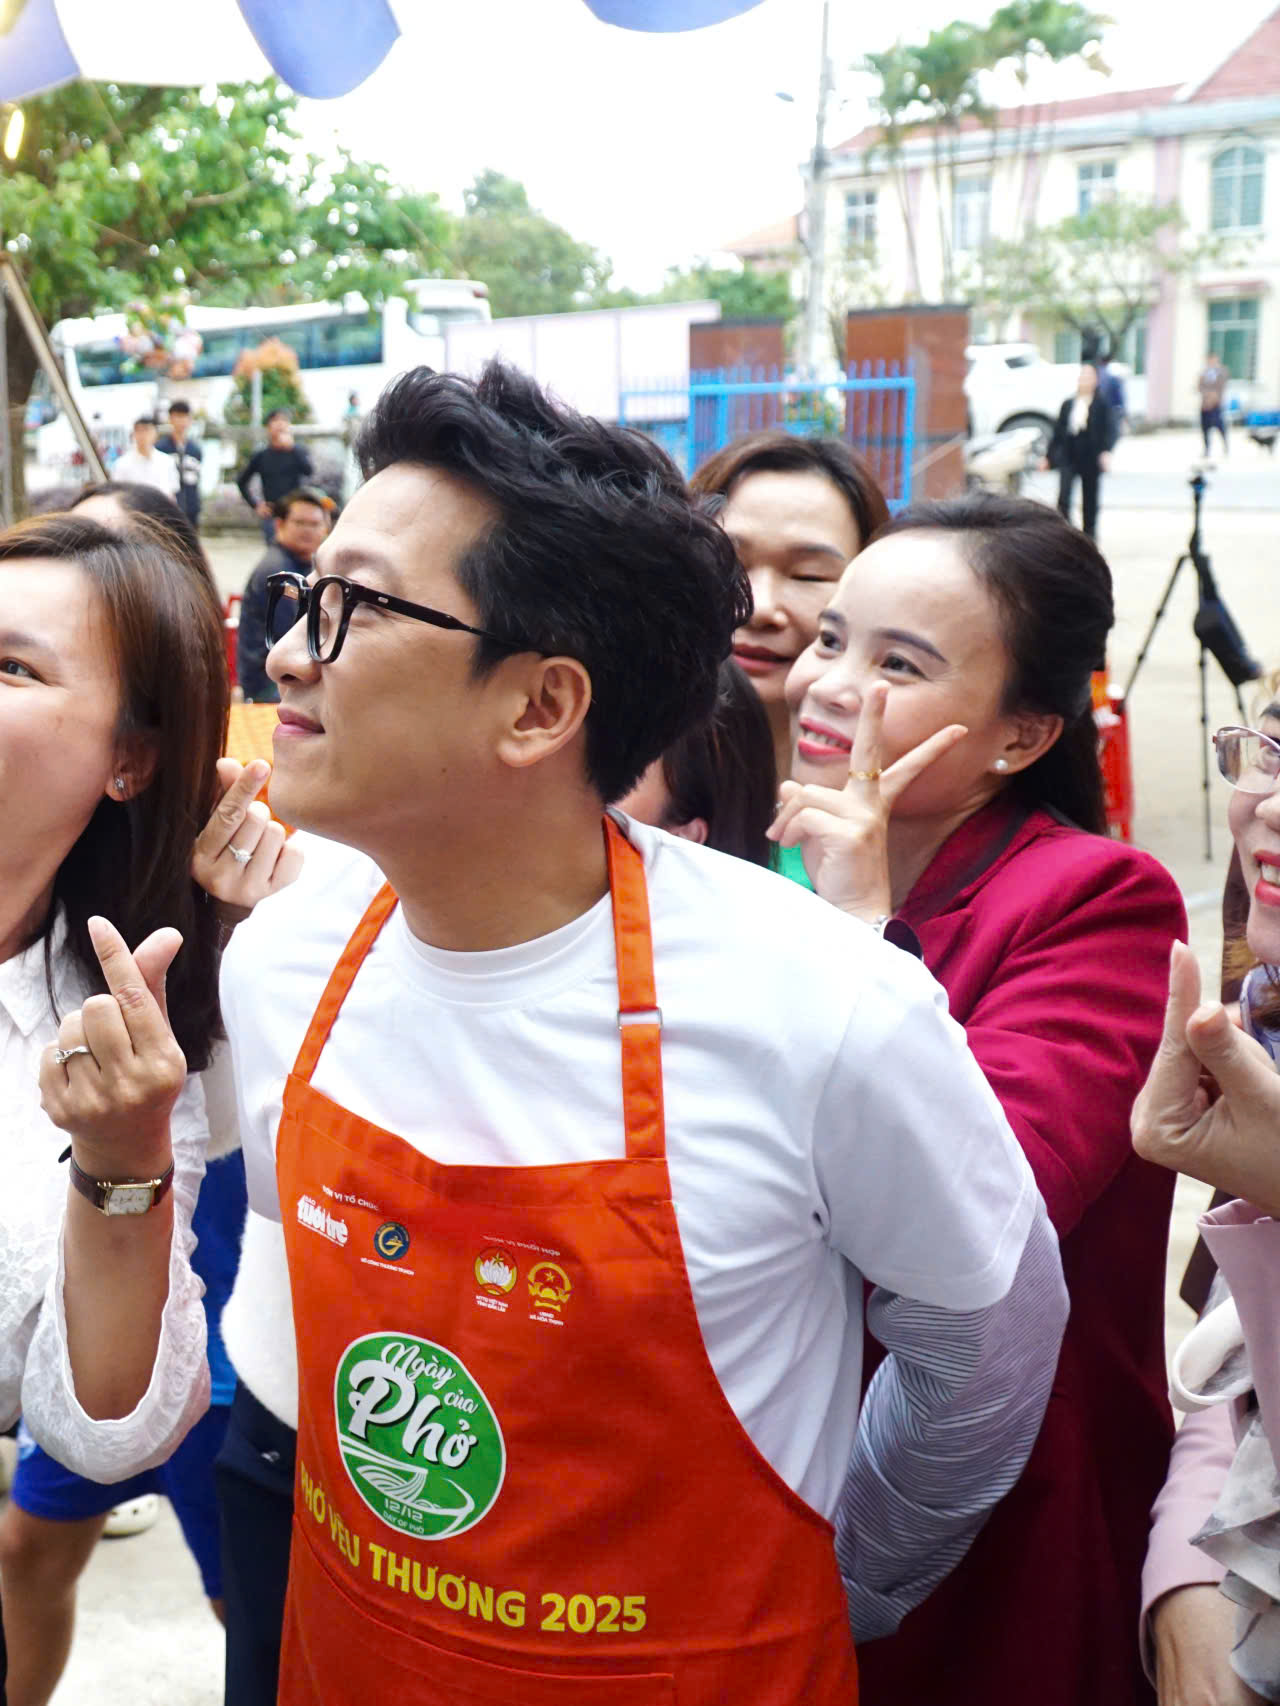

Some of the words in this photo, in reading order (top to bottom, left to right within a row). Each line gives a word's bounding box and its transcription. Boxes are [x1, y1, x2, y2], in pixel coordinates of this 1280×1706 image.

[334, 1192, 342, 1202] VỊ
[380, 1341, 457, 1390] Ngày
[348, 1359, 479, 1468] Phở
[443, 1389, 479, 1414] của
[383, 1510, 397, 1524] DAY
[397, 1518, 408, 1528] OF
[384, 1497, 424, 1523] 12/12
[300, 1459, 327, 1525] PHỞ
[328, 1502, 361, 1568] YÊU
[368, 1542, 526, 1628] THƯƠNG
[540, 1592, 647, 1634] 2025
